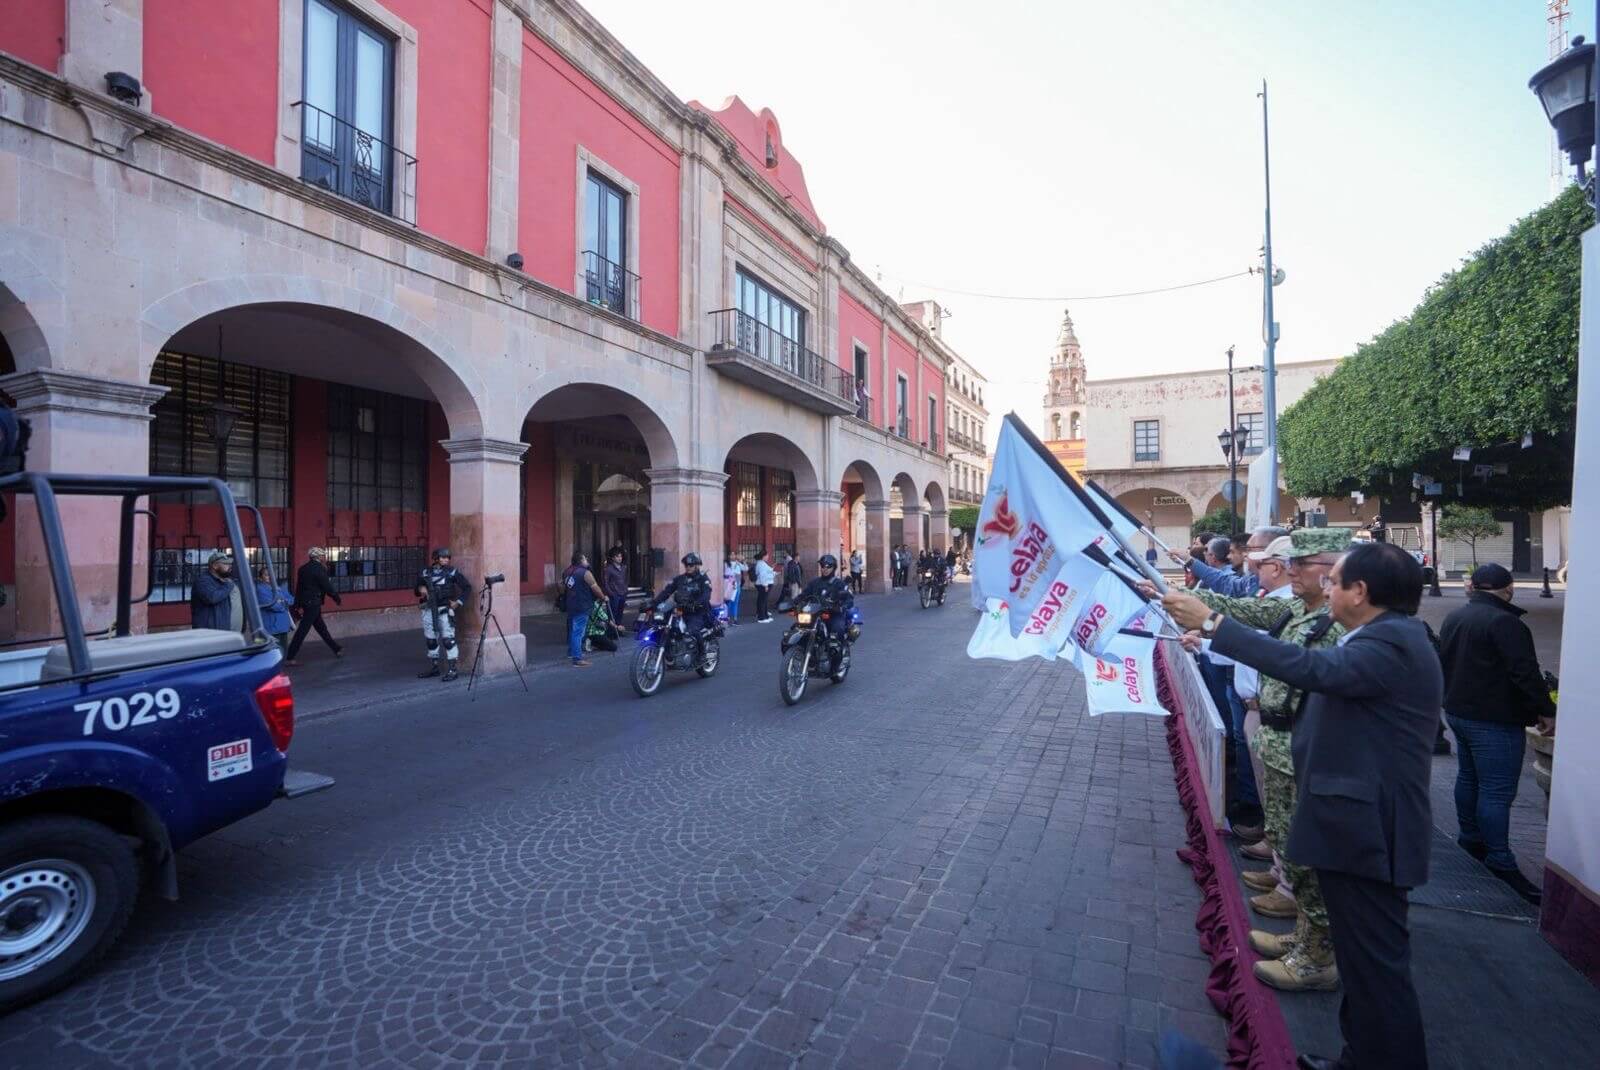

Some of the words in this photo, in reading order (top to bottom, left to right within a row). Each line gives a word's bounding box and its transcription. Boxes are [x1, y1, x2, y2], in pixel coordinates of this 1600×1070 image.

[1025, 579, 1070, 636] Celaya
[1123, 656, 1142, 704] Celaya
[73, 688, 181, 736] 7029
[213, 743, 246, 760] 911
